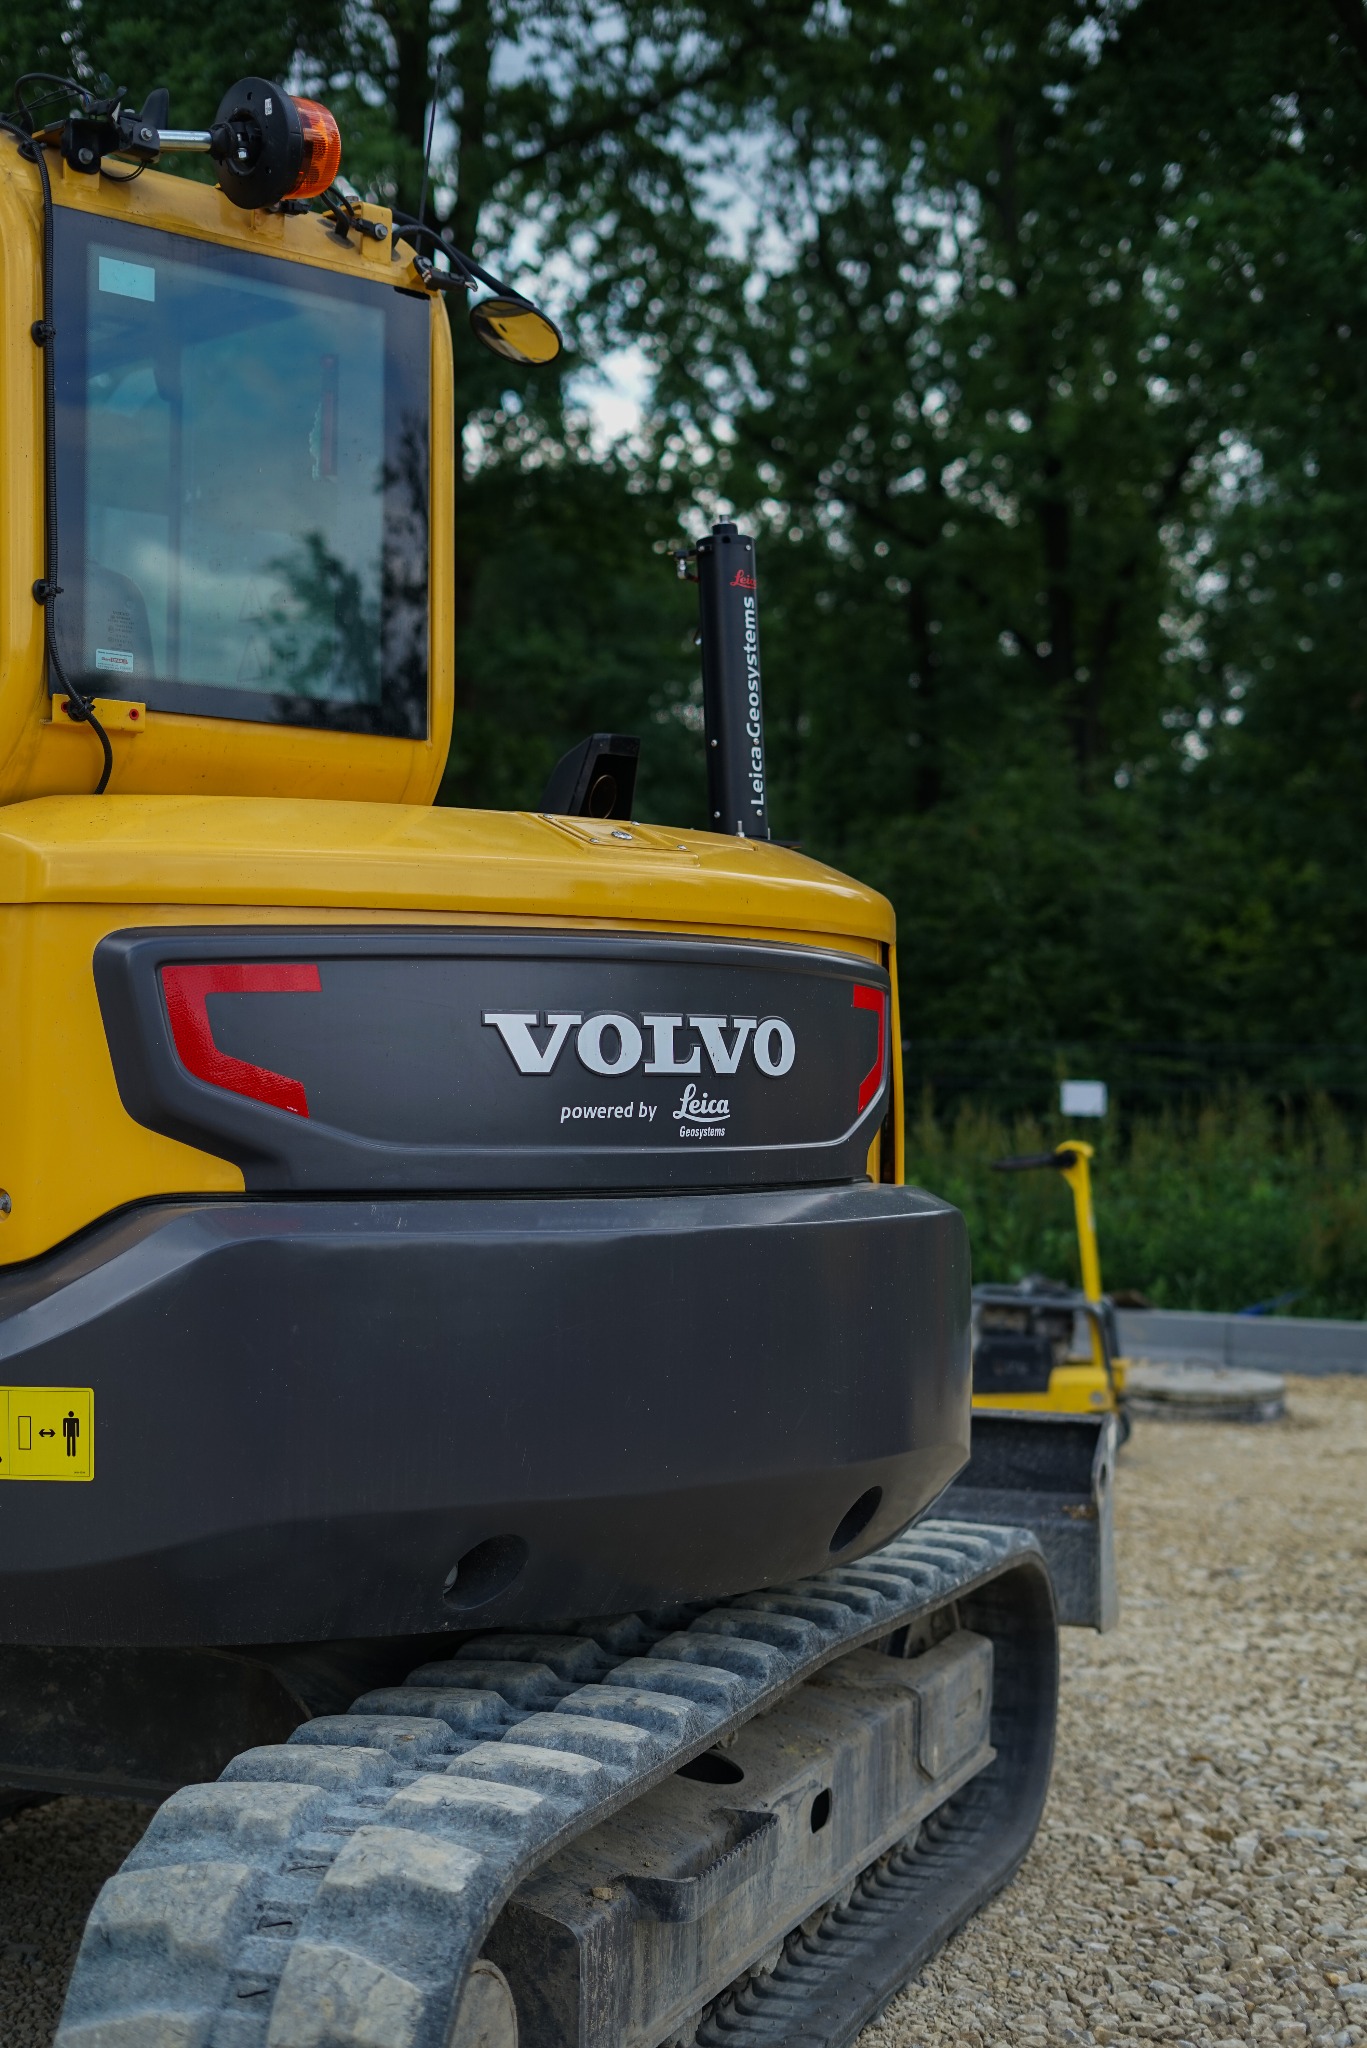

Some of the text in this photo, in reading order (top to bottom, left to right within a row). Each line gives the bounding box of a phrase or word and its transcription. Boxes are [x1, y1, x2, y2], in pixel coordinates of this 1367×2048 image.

[743, 596, 765, 806] Leica Geosystems
[483, 1013, 796, 1077] VOLVO
[560, 1083, 731, 1124] powered by Leica
[679, 1125, 726, 1140] Geosystems
